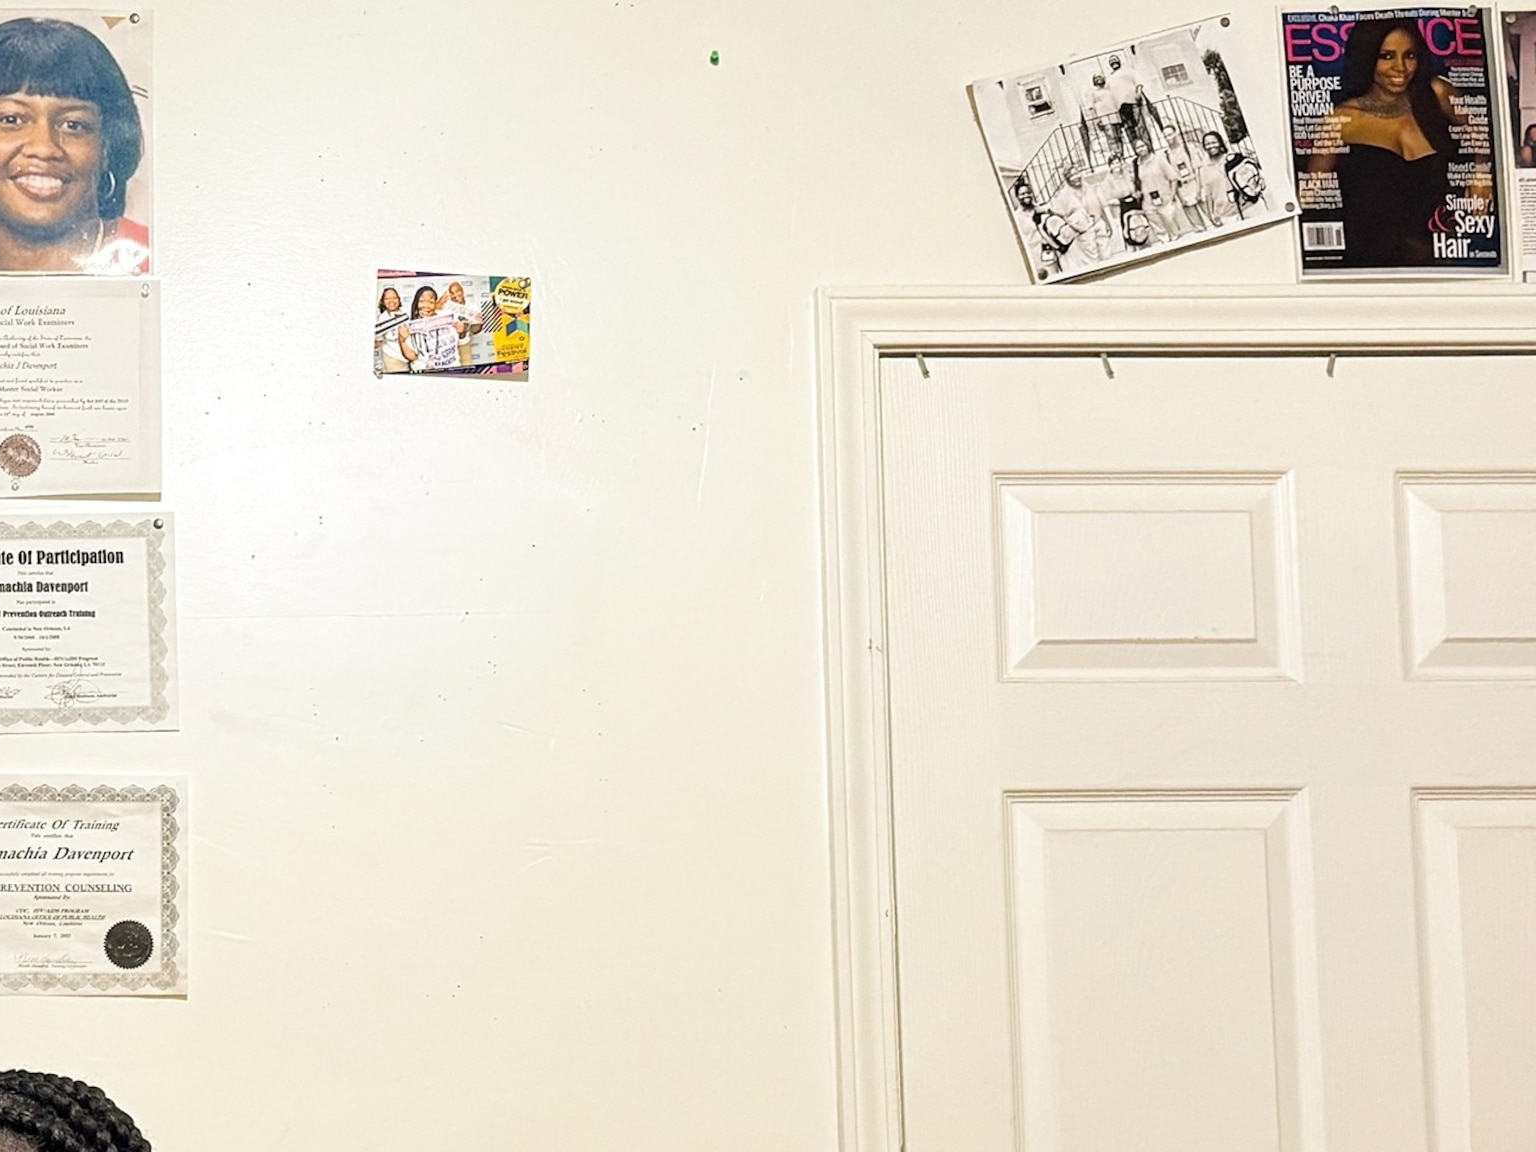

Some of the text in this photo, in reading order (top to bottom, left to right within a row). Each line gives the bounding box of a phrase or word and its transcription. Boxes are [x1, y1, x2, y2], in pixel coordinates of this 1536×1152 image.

[1339, 13, 1355, 21] Khan
[1375, 11, 1394, 19] Death
[1419, 9, 1440, 18] During
[1284, 18, 1483, 62] ESCE
[1288, 65, 1316, 79] BE A
[1290, 77, 1342, 92] PURPOSE
[1290, 90, 1331, 104] DRIVEN
[1291, 103, 1335, 117] WOMAN
[1446, 193, 1484, 212] Simple
[1455, 210, 1495, 238] Sexy
[1433, 232, 1471, 259] Hair
[0, 304, 14, 316] of
[14, 305, 67, 316] Louisiana
[15, 318, 36, 327] Work
[37, 317, 75, 327] Examiners
[17, 550, 33, 566] Of
[36, 549, 125, 567] Participation
[35, 580, 89, 594] Davenport
[51, 819, 71, 830] Of
[73, 819, 121, 832] Training
[52, 846, 135, 864] Davenport
[64, 883, 133, 892] COUNSELING
